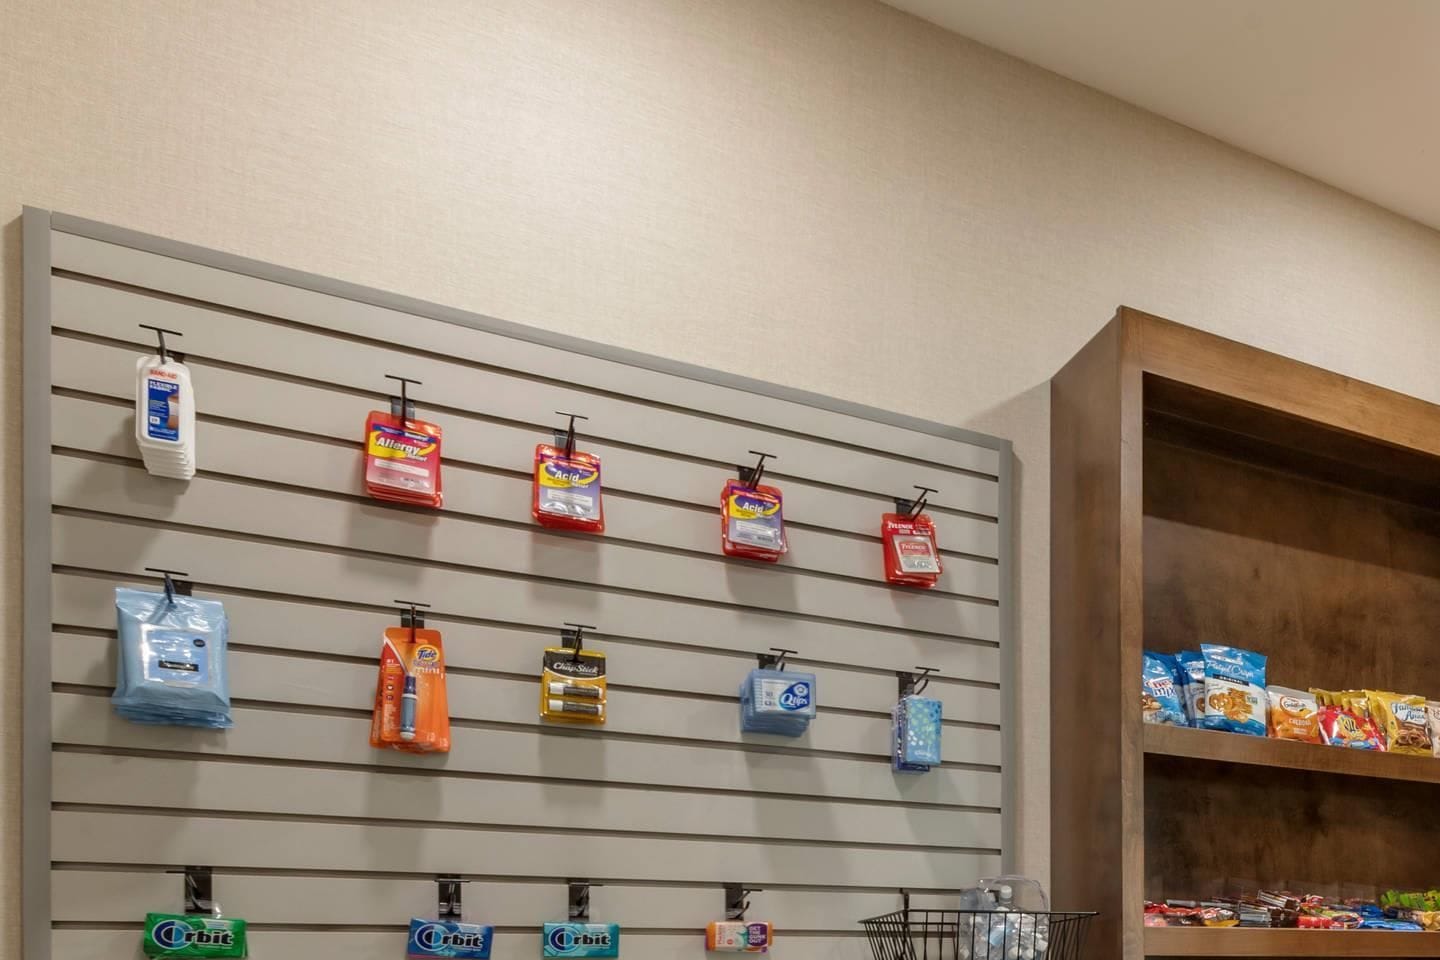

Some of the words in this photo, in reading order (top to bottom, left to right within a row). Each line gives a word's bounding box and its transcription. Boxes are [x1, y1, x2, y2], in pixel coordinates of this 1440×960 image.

[376, 437, 421, 457] Allergy
[554, 470, 580, 482] Acid
[742, 501, 764, 513] Acid
[416, 648, 438, 660] Tide
[553, 662, 599, 674] ChapStick
[152, 920, 234, 950] Orbit
[414, 923, 484, 951] Orbit
[550, 925, 611, 951] Orbit
